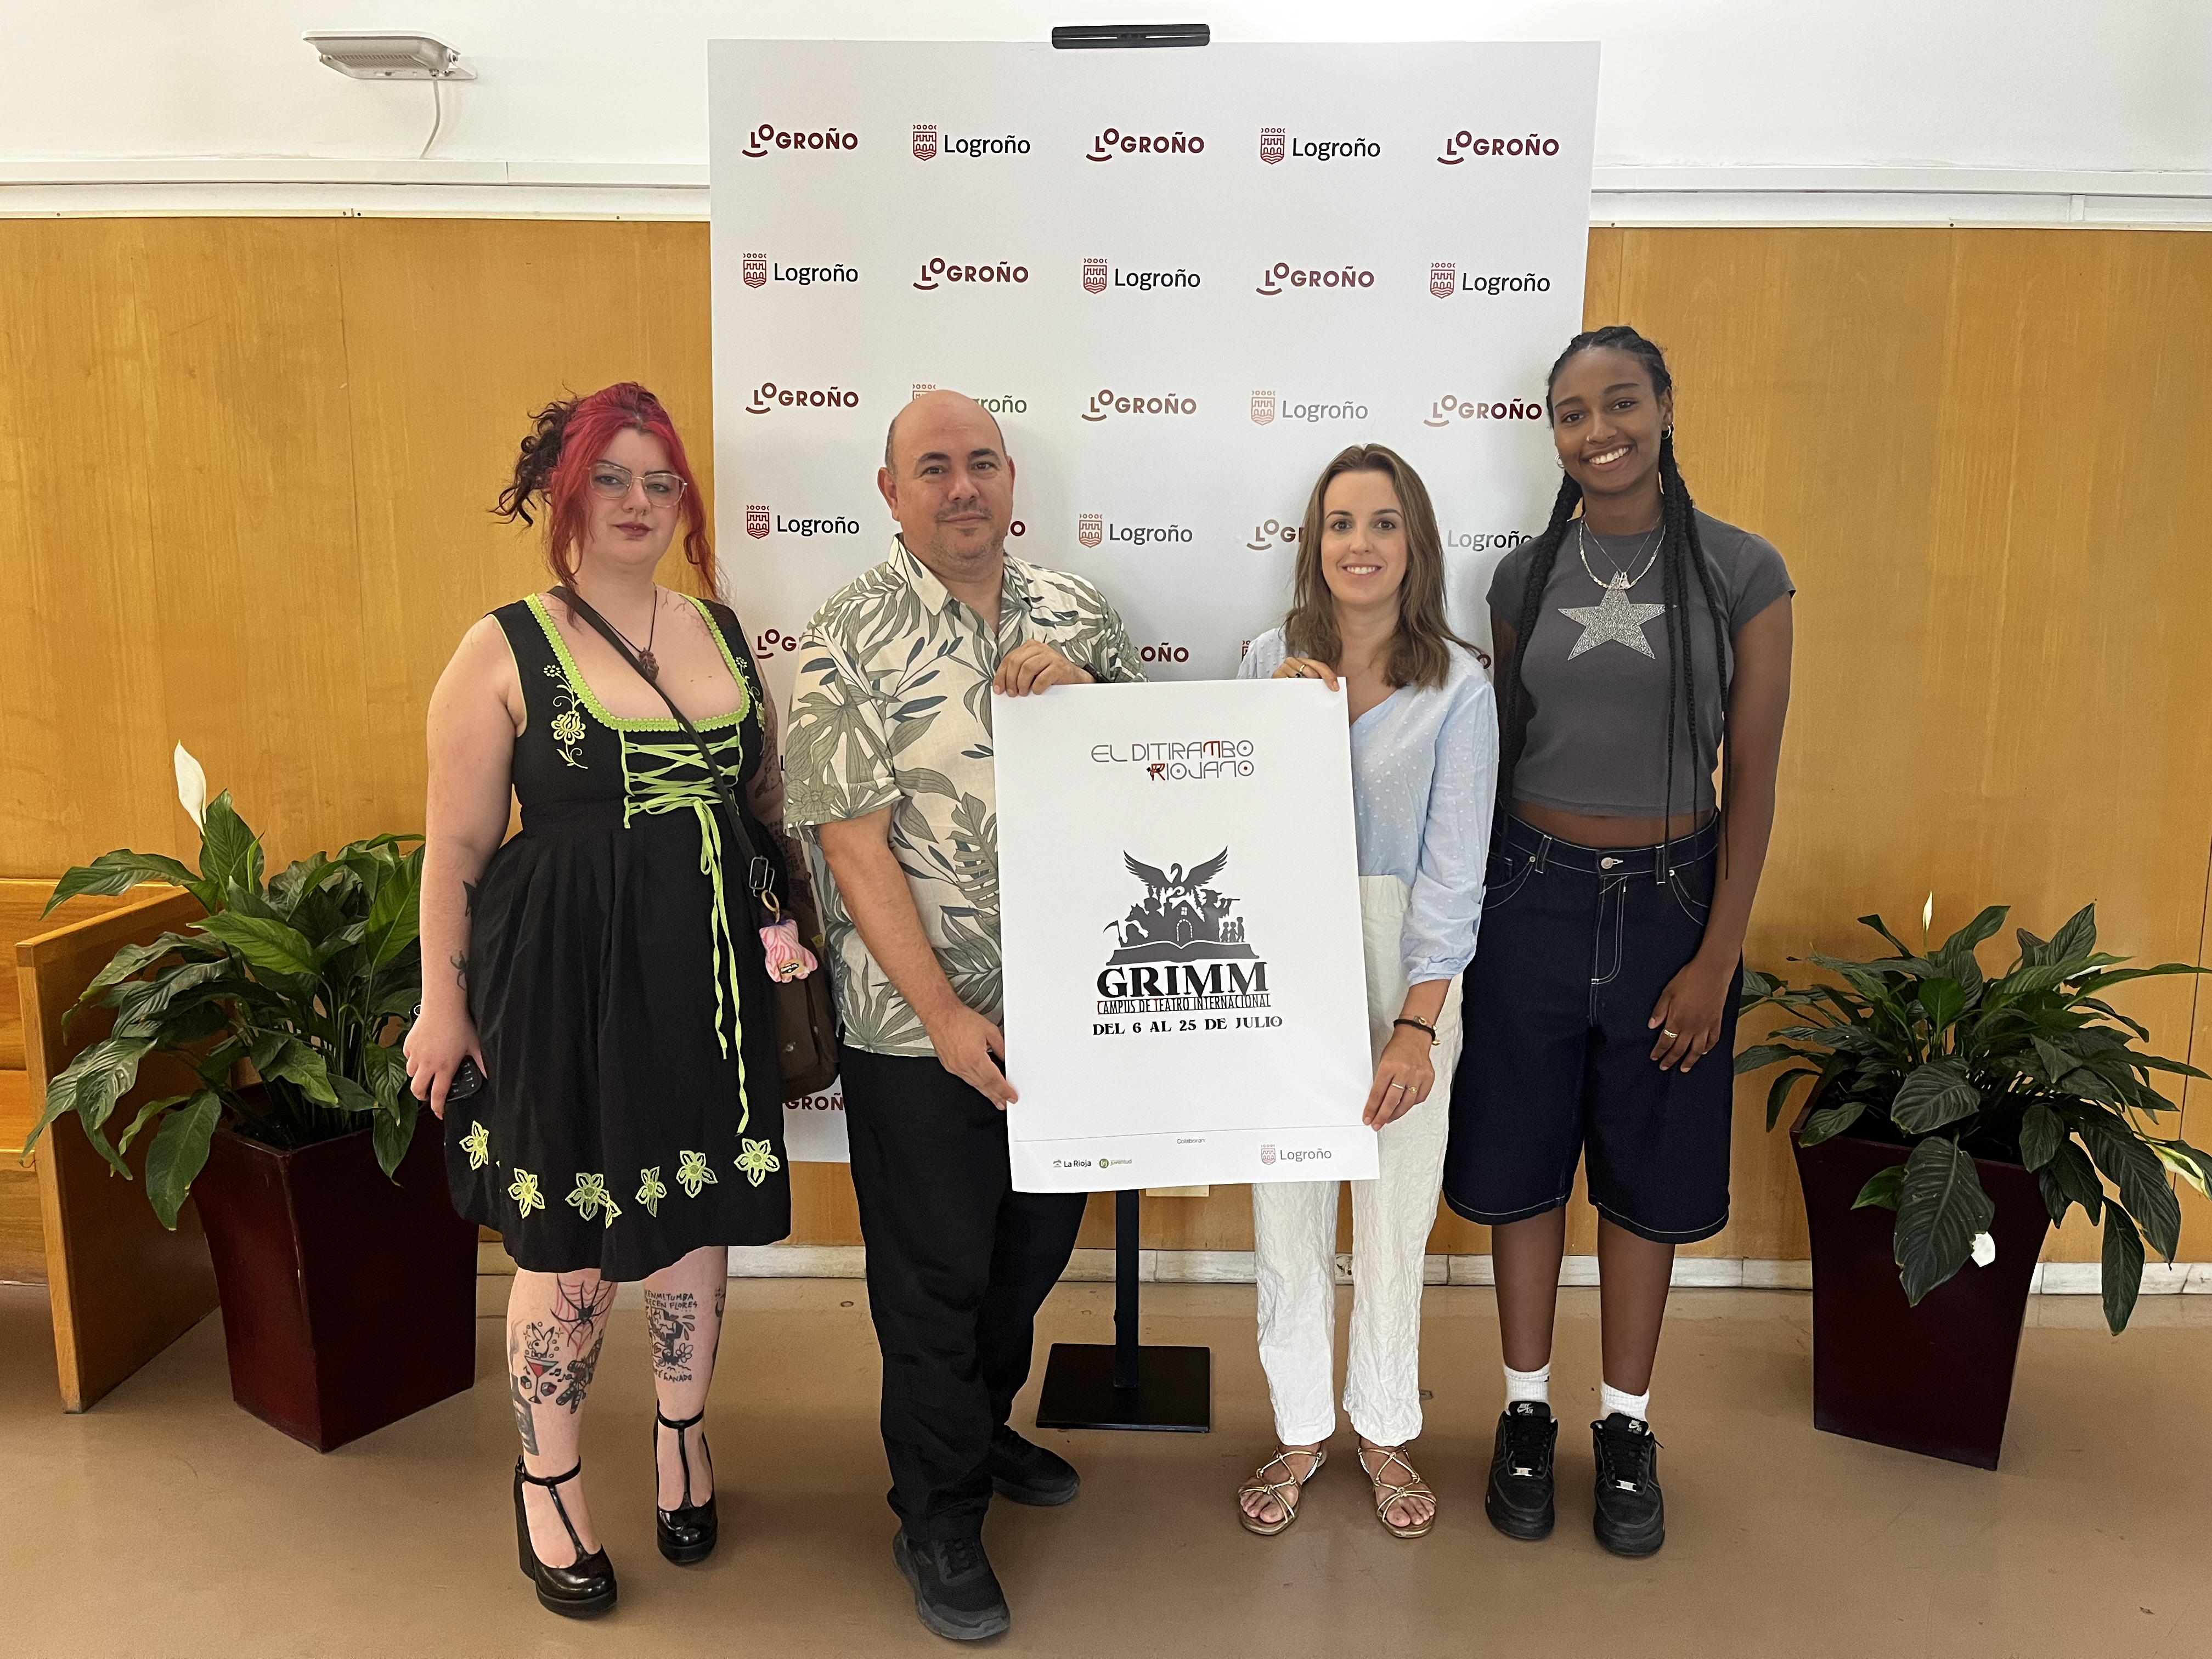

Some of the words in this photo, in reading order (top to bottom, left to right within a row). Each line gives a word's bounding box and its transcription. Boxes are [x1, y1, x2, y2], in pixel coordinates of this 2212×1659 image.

[751, 124, 858, 150] LOGROÑO
[945, 135, 1030, 157] Logroño
[1096, 128, 1204, 153] LOGROÑO
[1447, 131, 1559, 156] LOGROÑO
[1293, 138, 1380, 161] Logroño
[775, 263, 857, 285] Logroño
[922, 258, 1029, 283] LOGROÑO
[1115, 269, 1200, 290] Logroño
[1265, 263, 1374, 287] LOGROÑO
[1463, 273, 1550, 295] Logroño
[754, 383, 859, 407] LOGROÑO
[1090, 390, 1197, 414] LOGROÑO
[1283, 400, 1368, 422] Logroño
[1432, 394, 1542, 420] LOGROÑO
[777, 515, 859, 537] Logroño
[1110, 524, 1192, 545] Logroño
[1091, 744, 1127, 762] EL
[1132, 740, 1254, 761] DITIRAMBO
[1148, 760, 1254, 781] RIOJANO
[1097, 962, 1269, 997] GRIMM
[1097, 1000, 1136, 1015] CAMPUS
[1139, 998, 1151, 1013] DE
[1154, 997, 1189, 1012] TEATRO
[1194, 994, 1271, 1011] INTERNACIONAL
[1093, 1023, 1125, 1035] DEL
[1133, 1023, 1141, 1033] 6
[1150, 1021, 1171, 1032] AL
[1180, 1020, 1196, 1031] 25
[1205, 1018, 1227, 1030] DE
[1235, 1017, 1282, 1028] JULIO
[1280, 1148, 1332, 1163] Logroño
